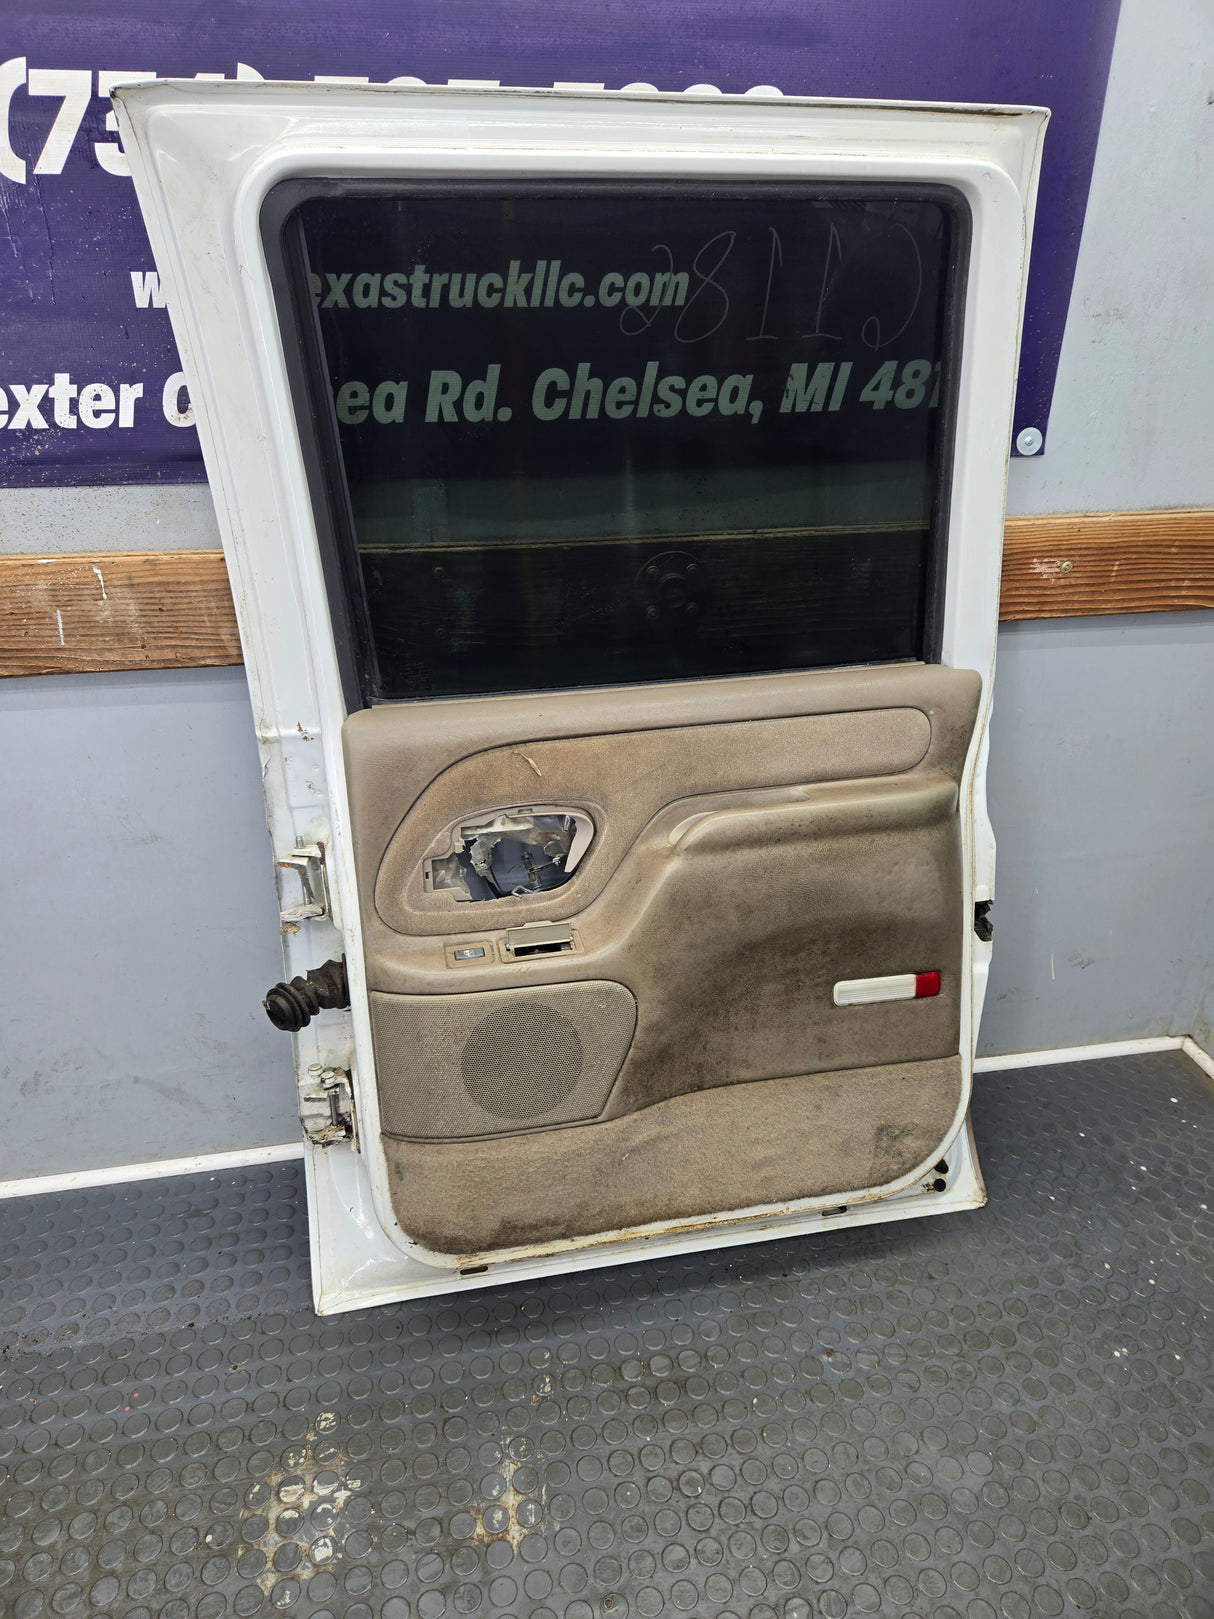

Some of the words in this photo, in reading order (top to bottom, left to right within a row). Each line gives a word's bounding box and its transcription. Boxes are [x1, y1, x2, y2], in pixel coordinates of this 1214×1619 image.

[0, 372, 144, 429] xter
[424, 363, 513, 424] Rd.
[531, 360, 764, 425] Chelsea,
[779, 361, 854, 413] MI
